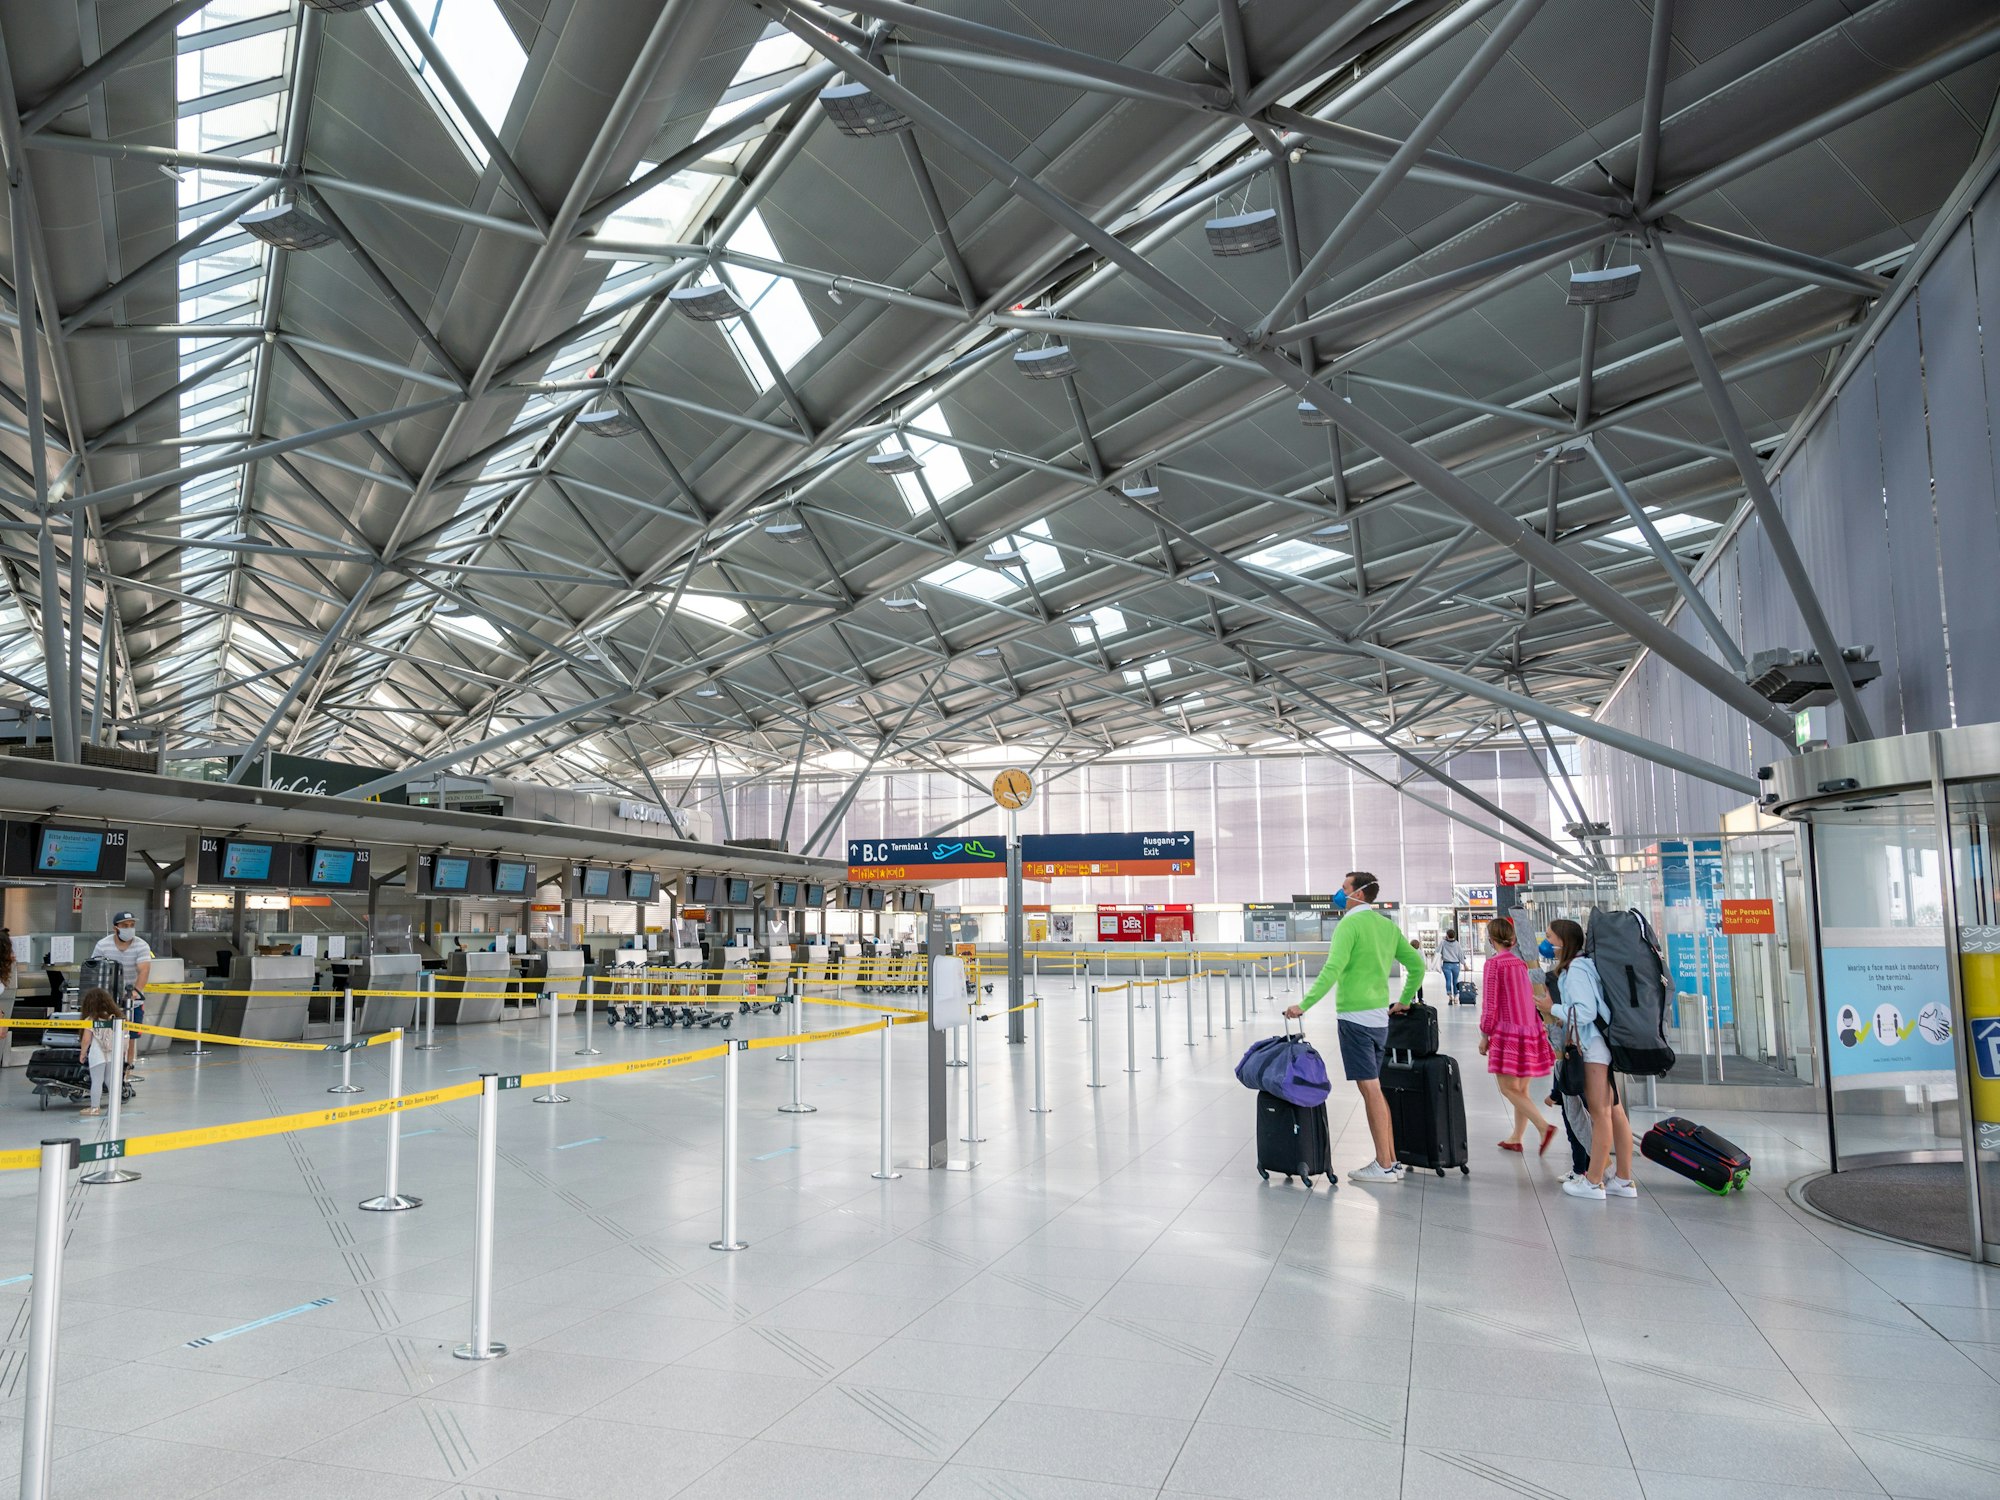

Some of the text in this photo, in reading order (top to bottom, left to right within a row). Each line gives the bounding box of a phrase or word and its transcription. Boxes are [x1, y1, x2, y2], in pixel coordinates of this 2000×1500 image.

[106, 832, 125, 846] D15
[1143, 836, 1176, 847] Ausgang
[202, 839, 218, 852] D14
[863, 842, 929, 862] B.C Terminal 1
[1143, 847, 1160, 856] Exit
[419, 856, 431, 867] D12
[1739, 908, 1771, 916] Personal
[1122, 919, 1142, 929] DER
[1725, 916, 1760, 925] Staff only
[1679, 961, 1708, 970] Ägypen
[1847, 964, 1866, 973] Wearing
[1908, 963, 1940, 972] mandatory
[1886, 973, 1913, 981] terminal.
[425, 1094, 439, 1103] Airport
[337, 1111, 348, 1119] Köln
[361, 1106, 377, 1115] Airport
